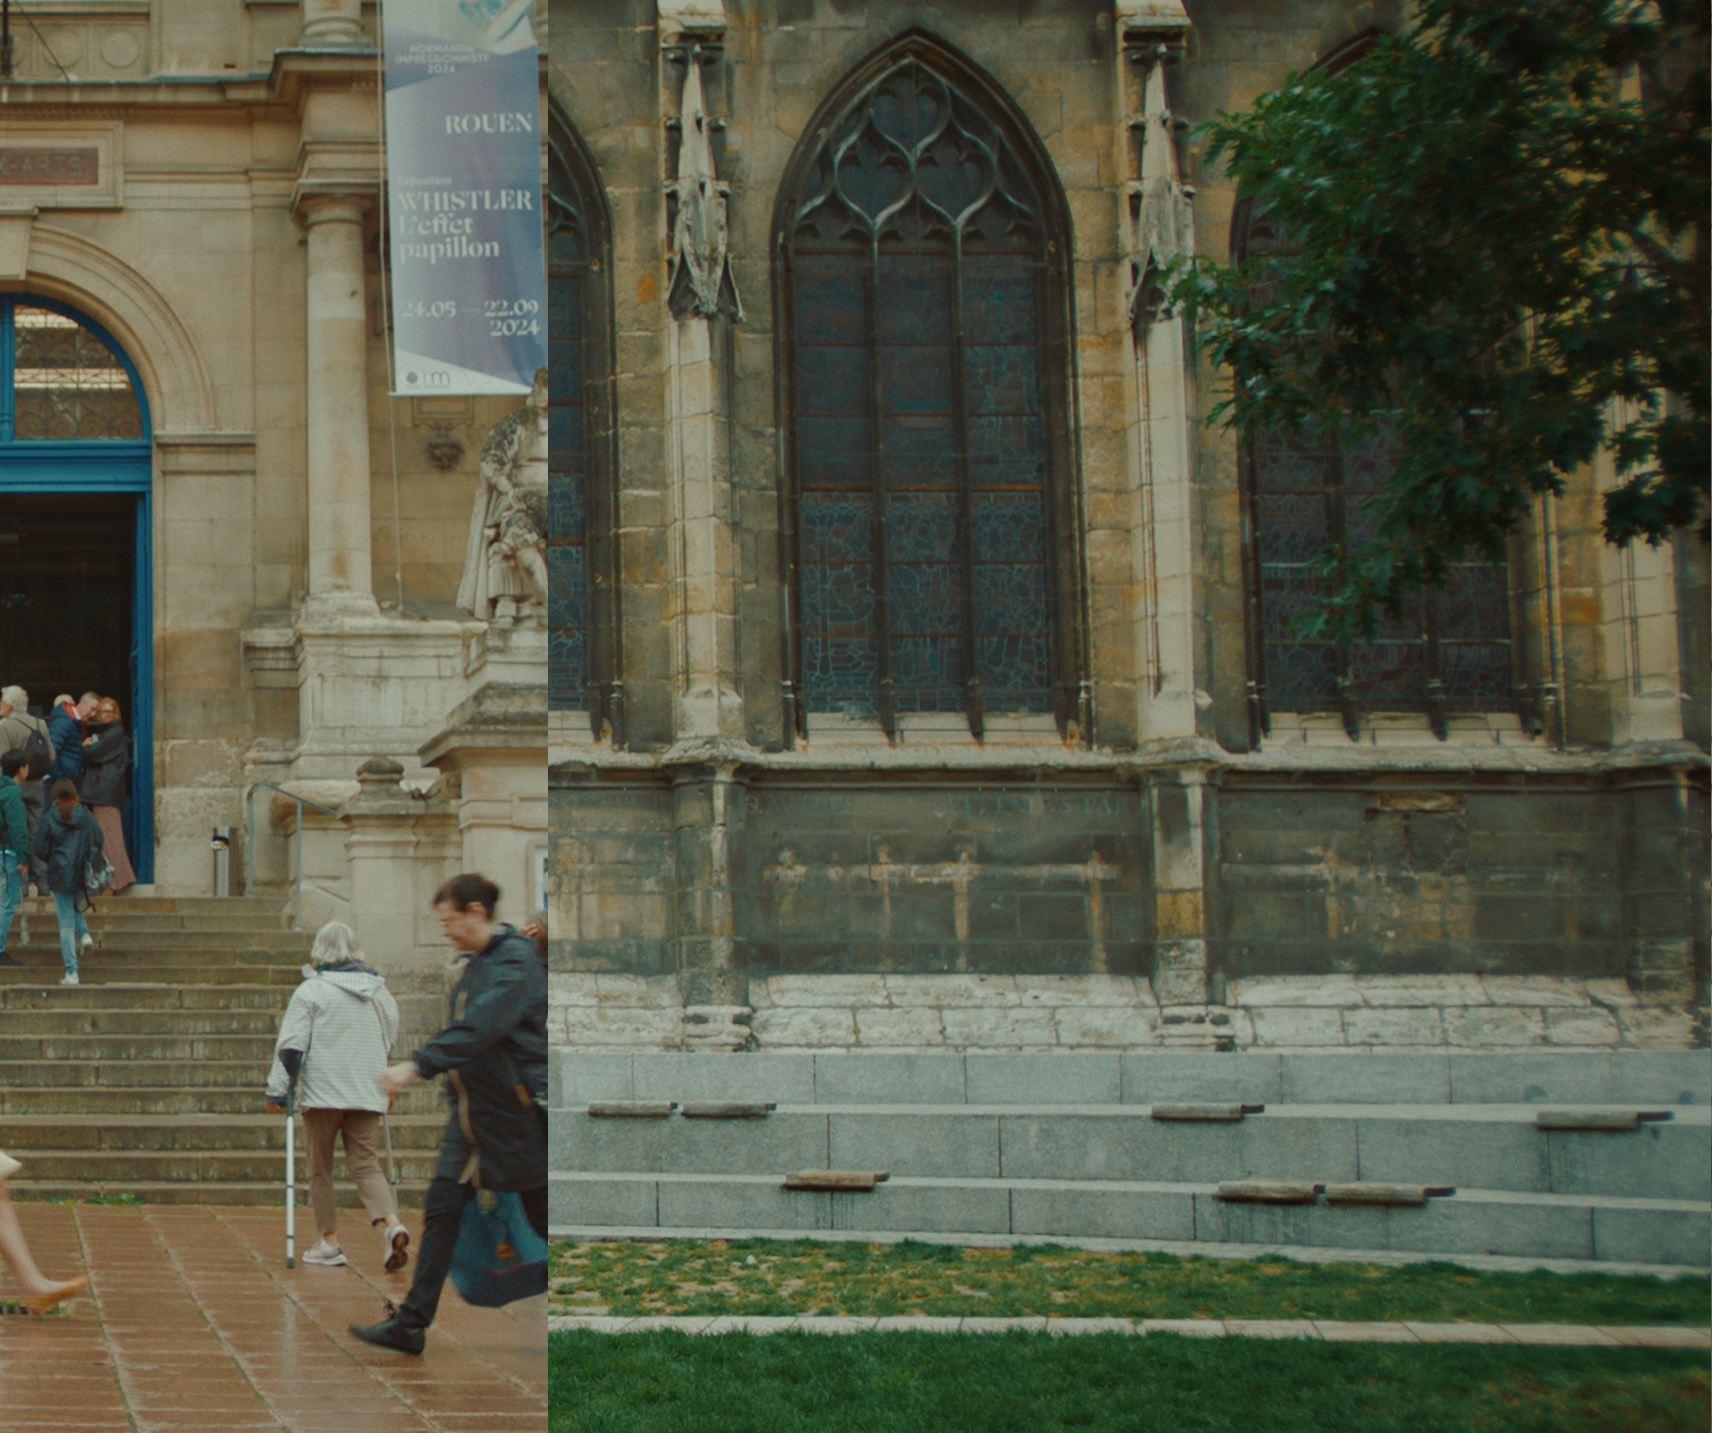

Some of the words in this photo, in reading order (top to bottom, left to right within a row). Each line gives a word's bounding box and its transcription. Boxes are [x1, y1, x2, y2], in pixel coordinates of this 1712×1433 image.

[445, 112, 533, 135] ROUEN
[398, 188, 533, 212] WHISTLER
[399, 235, 500, 265] papillon
[401, 301, 456, 318] 24.05
[485, 299, 538, 317] 22.09
[490, 318, 540, 337] 2024
